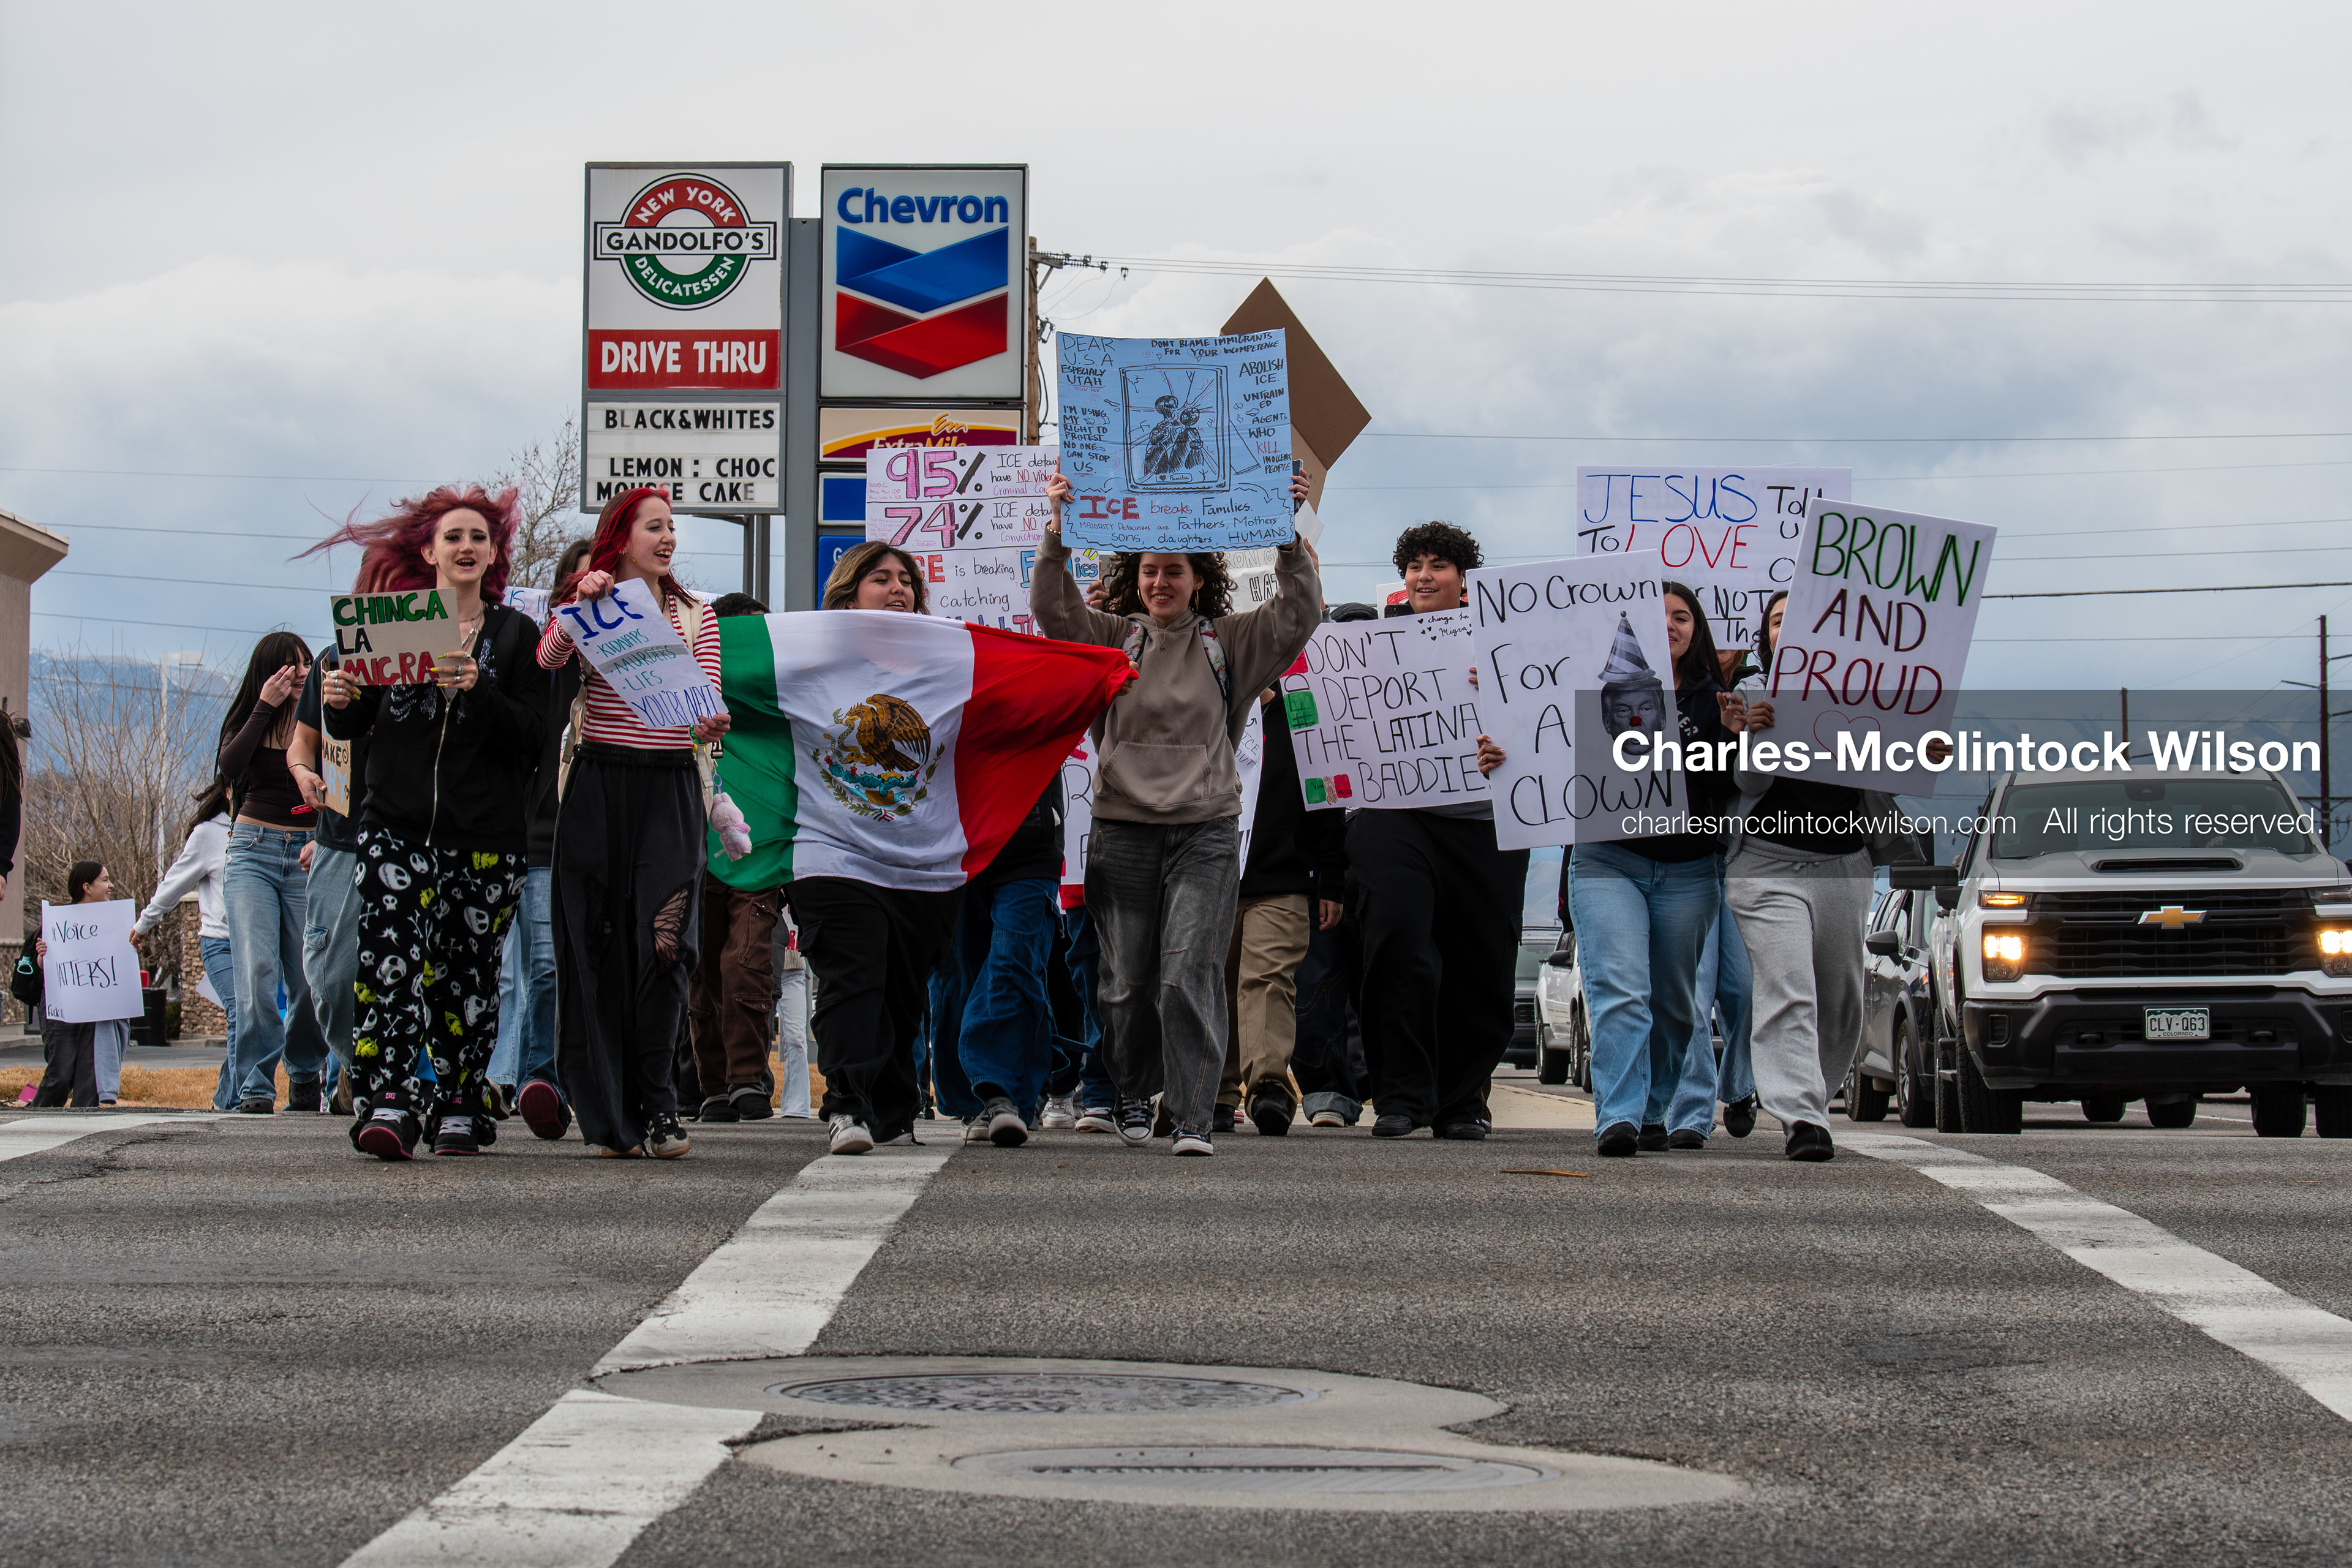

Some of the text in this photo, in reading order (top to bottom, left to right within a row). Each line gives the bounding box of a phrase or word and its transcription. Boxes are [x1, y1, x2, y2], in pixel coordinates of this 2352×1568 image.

[635, 186, 736, 224] NEW YORK
[837, 187, 1008, 224] Chevron
[606, 231, 764, 252] GANDOLFO'S
[634, 256, 736, 297] DELICATESSEN
[1062, 334, 1115, 352] DEAR
[1151, 331, 1273, 349] DONT BLAME IMMIGRANTS
[1190, 348, 1218, 356] YOUR
[601, 340, 767, 374] DRIVE THRU
[1239, 358, 1284, 378] ABOLISH
[1066, 374, 1102, 386] UTAH
[1256, 372, 1280, 385] ICE.
[1243, 387, 1284, 402] UNTRAIN
[1259, 399, 1272, 409] ED
[605, 409, 775, 429] BLACK&WHITES
[1063, 405, 1107, 418] I'M USING
[1063, 415, 1079, 424] MY
[1063, 424, 1094, 433] RIGHT
[1248, 427, 1276, 439] WHO
[1063, 440, 1077, 449] NO
[1066, 450, 1110, 462] CAN STOP
[1256, 440, 1281, 454] KILL
[609, 458, 682, 477] LEMON
[715, 458, 775, 478] CHOC
[997, 453, 1023, 469] ICE
[886, 449, 987, 500] 95%
[990, 470, 1012, 483] have
[1017, 469, 1030, 483] NO
[597, 481, 755, 502] MOE CAKE
[993, 483, 1028, 496] Criminal
[1584, 474, 1758, 524] JESUS
[992, 502, 1018, 518] ICE
[1078, 495, 1253, 521] ICE breaks Families.
[884, 502, 984, 548] 74%
[990, 519, 1013, 531] have
[1022, 517, 1037, 530] NO
[1079, 521, 1114, 530] MAJORITY
[1118, 522, 1151, 531] Detainees
[1177, 516, 1229, 530] Fathers,
[1234, 516, 1277, 528] Mothers
[1578, 525, 1620, 553] To
[955, 565, 966, 578] is
[973, 556, 1016, 581] breaking
[1812, 511, 1980, 607] BROWN
[940, 586, 1010, 612] catching
[1546, 575, 1658, 609] Crown
[1714, 584, 1774, 619] NOT
[333, 590, 449, 627] CHINGA
[560, 587, 644, 639] ICE
[1812, 588, 1926, 652] AND
[335, 627, 374, 655] LA
[597, 627, 649, 658] KIDNAPS
[1303, 630, 1406, 674] DON'T
[343, 651, 440, 685] MIGRA
[613, 645, 676, 675] MURDERS
[624, 670, 663, 691] LIES
[1490, 643, 1570, 704] For
[1771, 646, 1943, 715] PROUD
[1322, 668, 1447, 722] DEPORT
[631, 690, 690, 727] YOU'RE
[1294, 703, 1483, 765] THE LATINA
[1535, 704, 1572, 754] A
[1357, 753, 1492, 802] BADDIE
[1510, 768, 1673, 826] CLOWN
[55, 920, 98, 943] Voice
